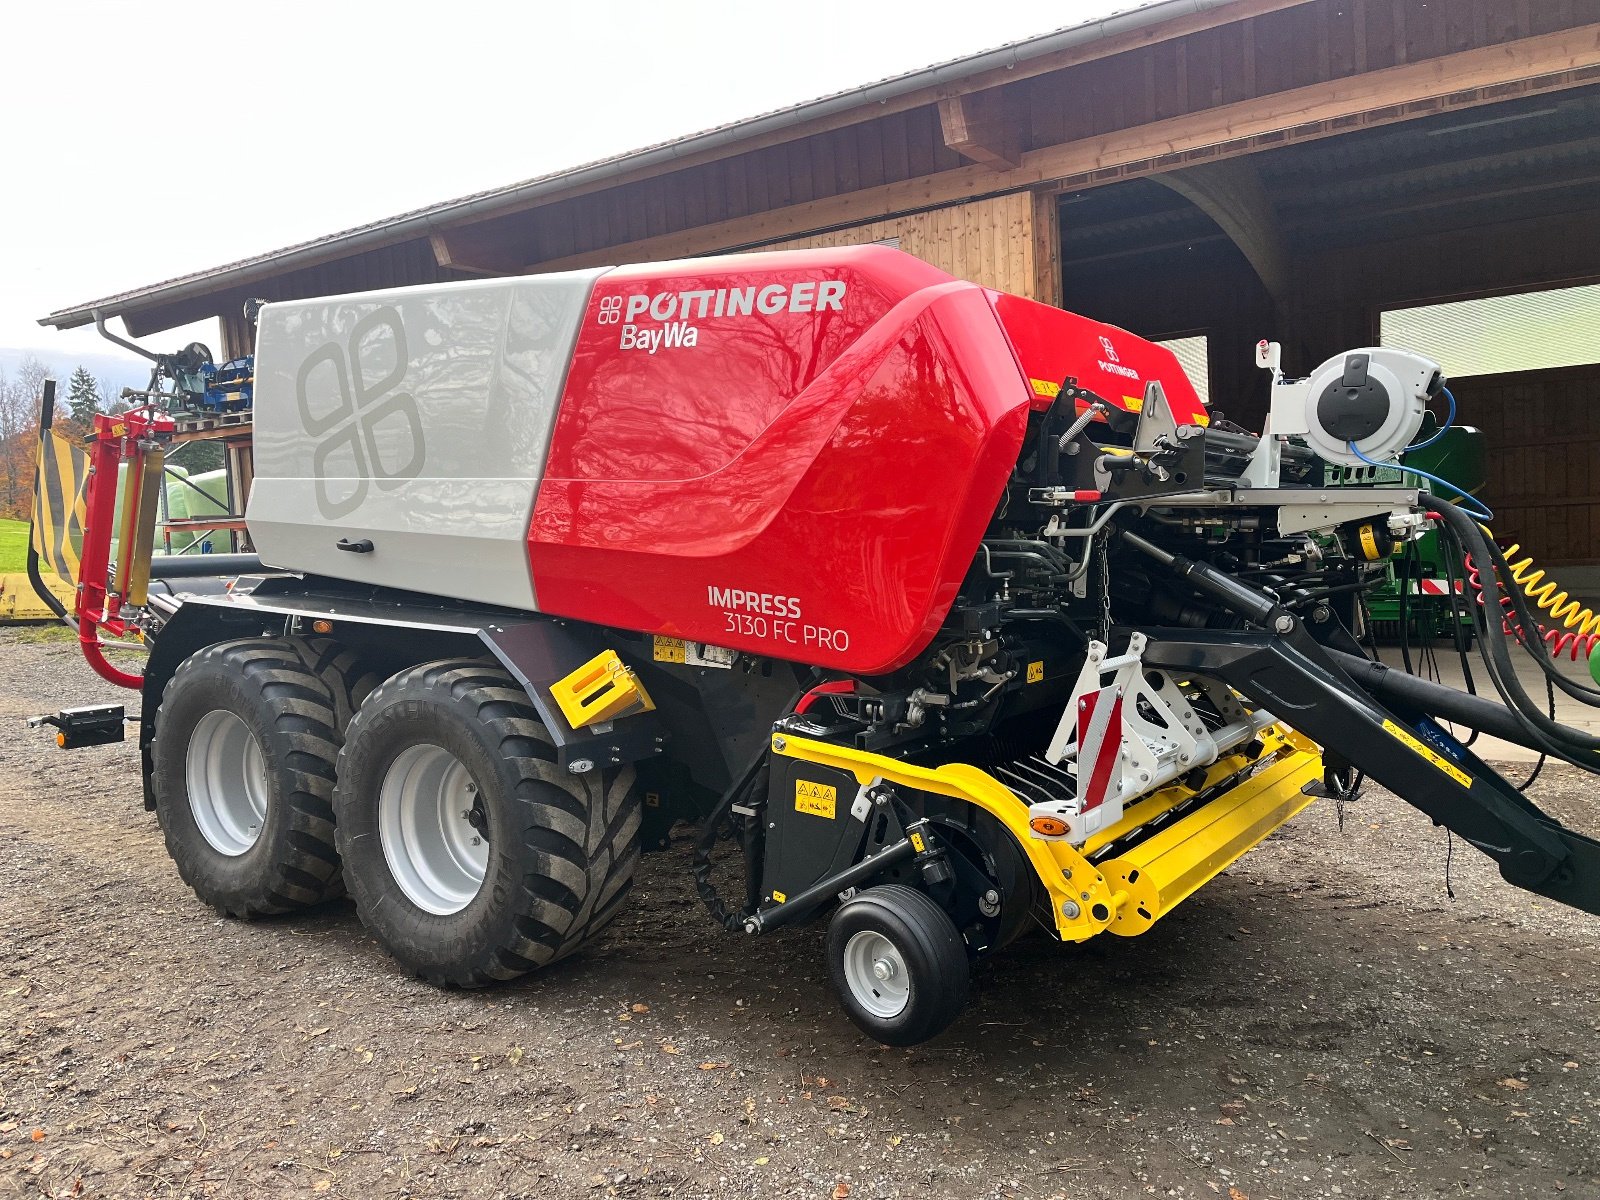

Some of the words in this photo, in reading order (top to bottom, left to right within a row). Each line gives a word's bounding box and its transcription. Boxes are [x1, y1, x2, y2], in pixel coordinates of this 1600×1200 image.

[619, 322, 698, 354] BayWa
[707, 585, 801, 619] IMPRESS
[723, 611, 767, 638] 3130
[773, 620, 797, 643] FC
[803, 625, 850, 652] PRO
